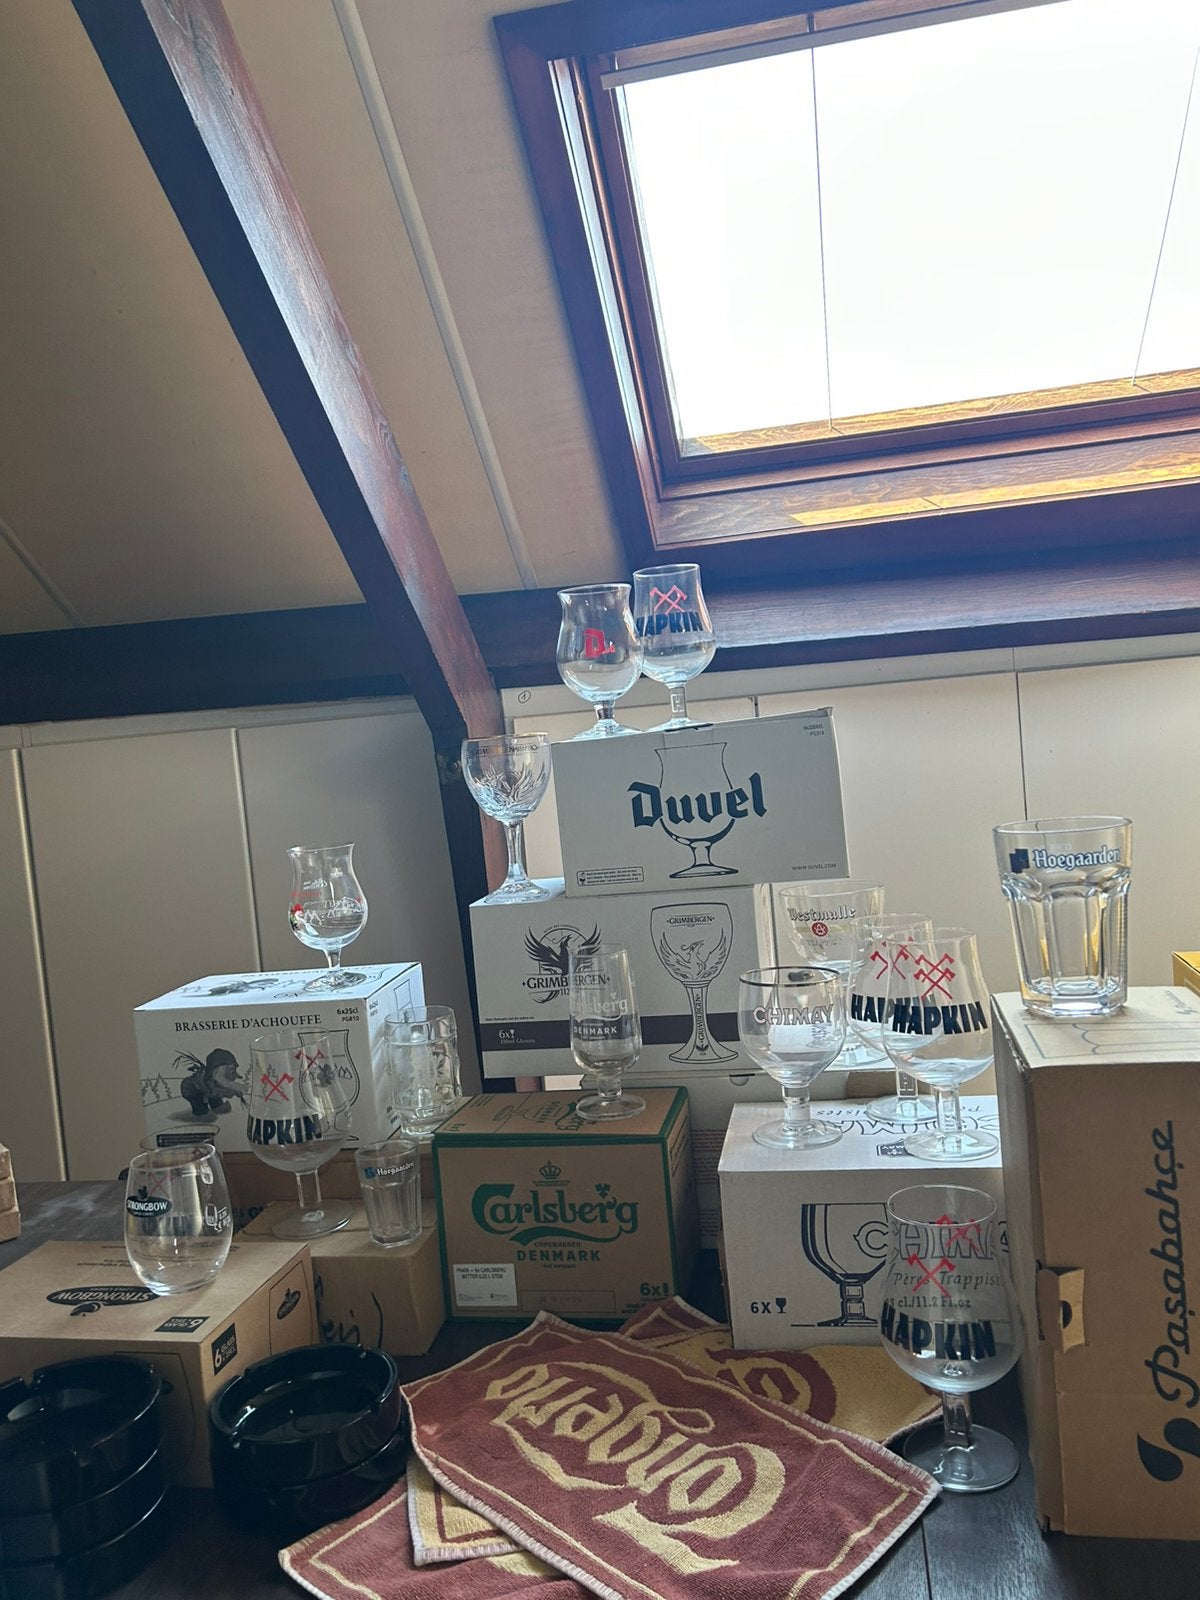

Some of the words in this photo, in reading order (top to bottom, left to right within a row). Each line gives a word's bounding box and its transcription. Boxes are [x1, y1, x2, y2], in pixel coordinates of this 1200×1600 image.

[627, 772, 768, 828] Duvel
[1033, 844, 1121, 871] Hoegaarden
[788, 904, 857, 921] Westmalle
[336, 1007, 359, 1016] 6x25cl
[752, 1003, 834, 1026] CHIMAY
[892, 1001, 988, 1035] HAPKIN
[174, 1018, 239, 1033] BRASSERIE
[241, 1014, 322, 1029] D'ACHOUFFE
[573, 1026, 617, 1035] DENMARK
[127, 1199, 168, 1213] STRONGBOW
[471, 1183, 639, 1236] Carlsberg
[516, 1250, 601, 1262] DENMARK
[53, 1291, 152, 1302] STRONGBOW
[880, 1301, 997, 1361] HAPKIN
[214, 1344, 222, 1369] 6
